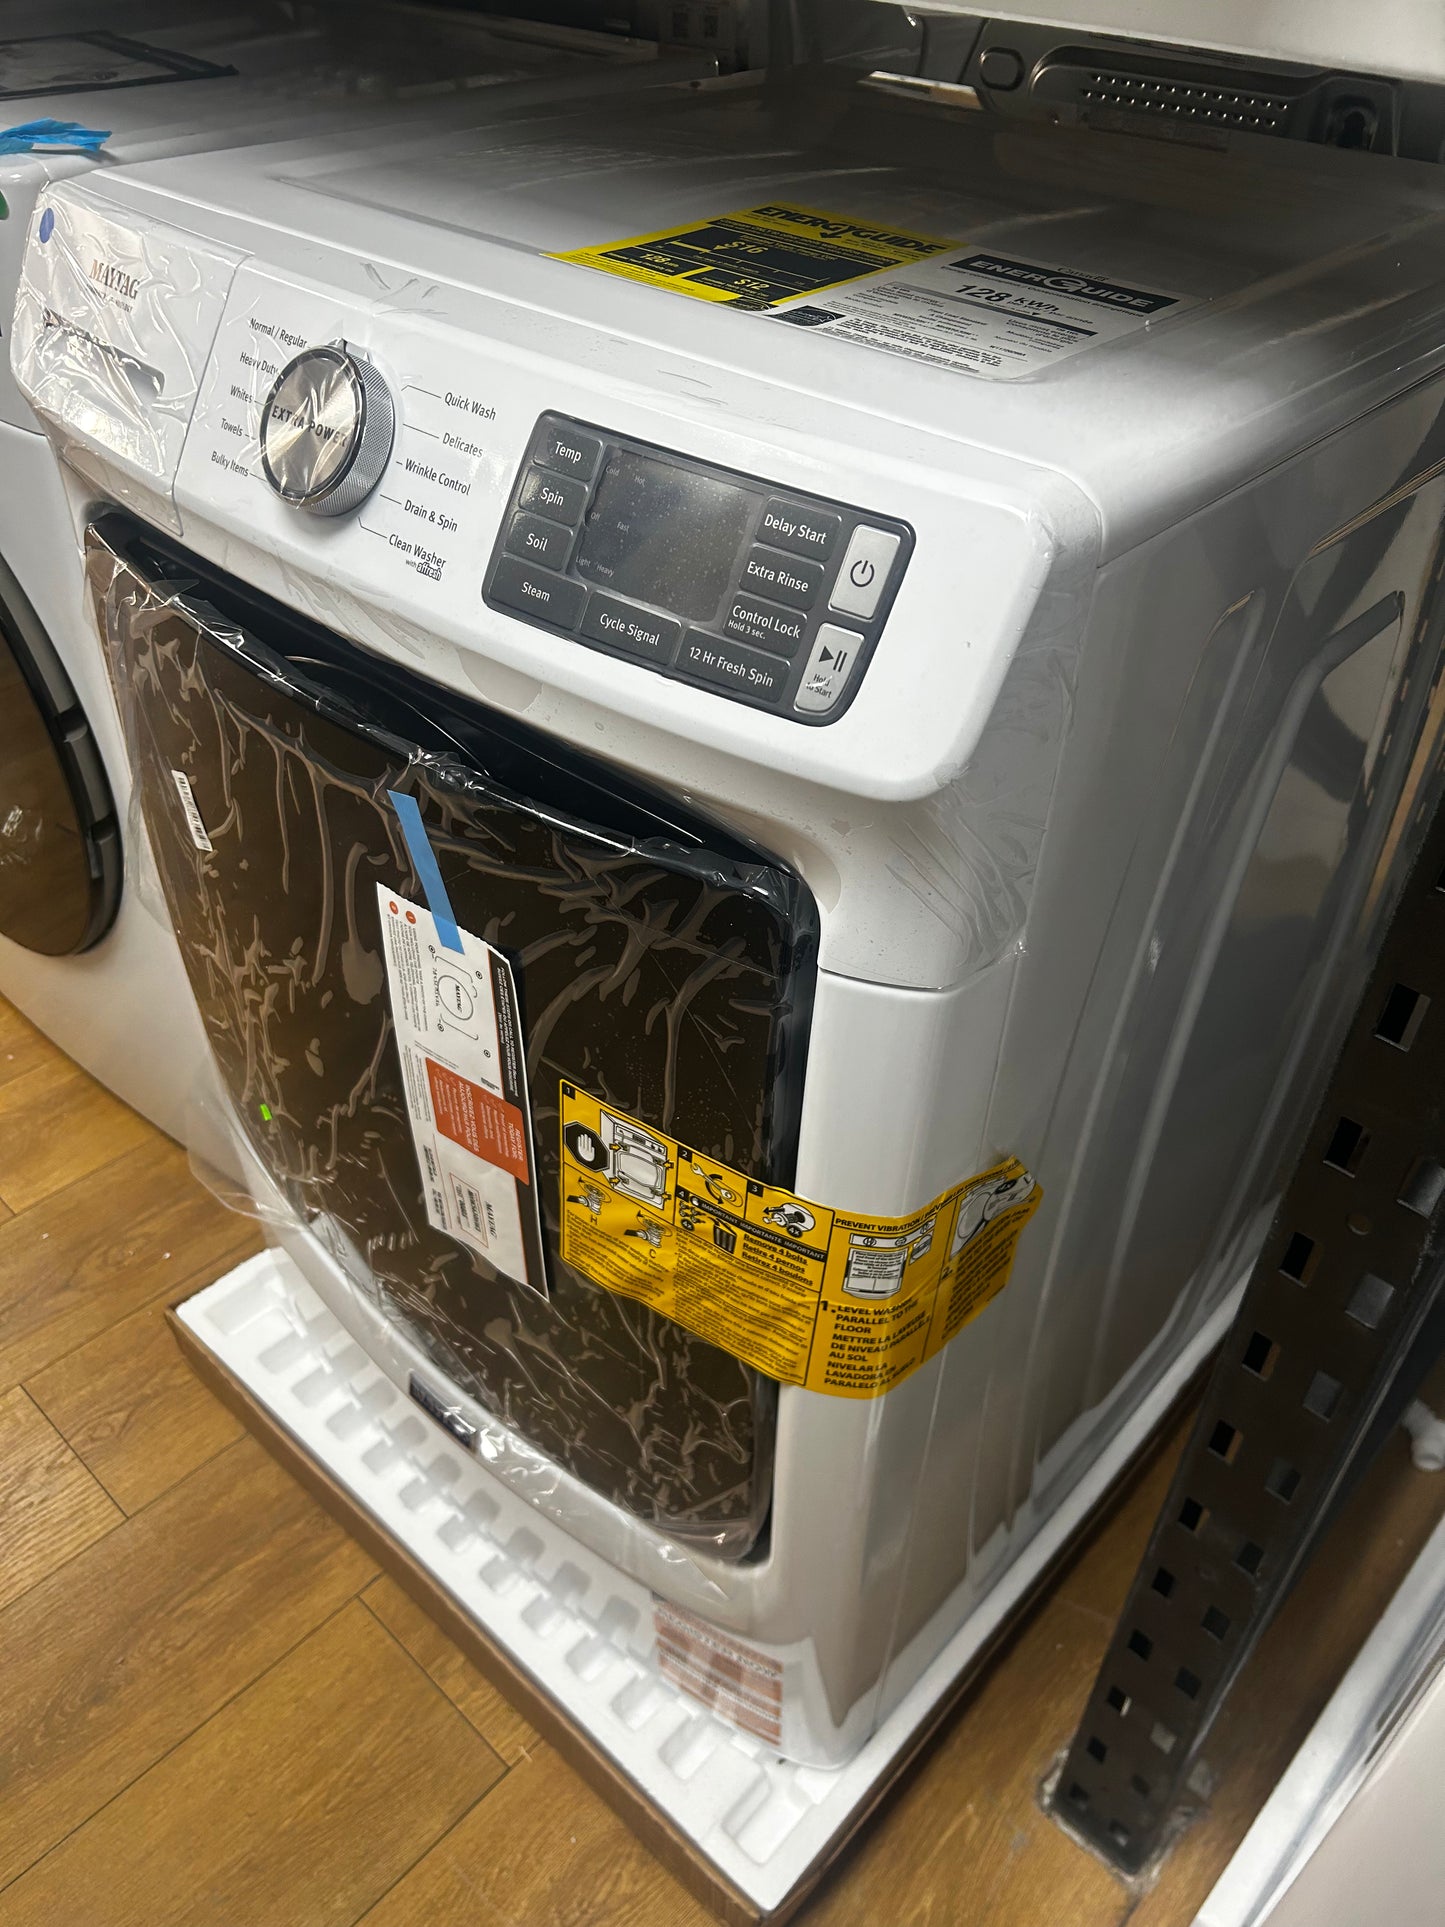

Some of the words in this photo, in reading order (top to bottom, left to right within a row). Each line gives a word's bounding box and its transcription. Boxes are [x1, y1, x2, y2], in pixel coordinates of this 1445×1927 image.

[752, 206, 948, 255] ENERGYGUIDE
[89, 258, 140, 300] MAYTAG
[969, 260, 1154, 308] ENERGUIDE
[955, 284, 1013, 301] 128
[1013, 297, 1059, 312] kWh
[249, 318, 275, 336] Normal
[280, 329, 308, 349] Regular
[240, 352, 260, 369] Heavy
[230, 385, 253, 404] Whites
[444, 392, 469, 411] Quick
[471, 401, 497, 421] Wash
[221, 418, 243, 437] Towels
[271, 405, 305, 428] EXTRA
[308, 419, 349, 447] POWER
[442, 432, 484, 458] Delicates
[555, 441, 582, 464] Temp
[211, 451, 231, 467] Bulky
[231, 460, 249, 477] Items
[605, 466, 620, 476] Cold
[405, 458, 437, 482] Wrinkle
[438, 472, 471, 496] Control
[539, 486, 565, 507] Spin
[404, 499, 427, 519] Drain
[428, 510, 436, 523] &
[437, 514, 459, 532] Spin
[590, 511, 601, 521] Off
[617, 521, 630, 533] Fast
[764, 513, 797, 537] Delay
[797, 524, 827, 545] Start
[389, 534, 413, 553] Clean
[413, 545, 446, 569] Washer
[525, 532, 548, 552] Soil
[405, 559, 417, 568] with
[416, 562, 443, 581] affresh
[575, 556, 591, 567] Light
[597, 563, 614, 577] Heavy
[747, 561, 774, 581] Extra
[777, 571, 809, 592] Rinse
[521, 581, 551, 602] Steam
[600, 613, 626, 634] Cycle
[627, 623, 661, 646] Signal
[728, 620, 745, 633] Hold
[746, 626, 751, 634] 3
[751, 629, 766, 640] sec.
[732, 605, 773, 629] Control
[774, 620, 801, 639] Lock
[689, 646, 701, 660] 12
[702, 651, 715, 665] Hr
[717, 656, 746, 677] Fresh
[747, 668, 774, 687] Spin
[813, 674, 830, 686] Hold
[814, 684, 832, 699] Start
[485, 1200, 497, 1239] MAYTAG
[590, 1214, 598, 1225] H
[835, 1218, 875, 1230] PREVENT
[878, 1218, 920, 1232] VIBRATION
[702, 1202, 738, 1224] IMPORTANT
[740, 1219, 782, 1243] IMPORTANTE
[784, 1240, 825, 1259] IMPORTANT
[649, 1249, 657, 1259] C
[743, 1243, 768, 1256] Retire
[776, 1255, 805, 1274] pernos
[744, 1233, 778, 1251] Remove
[784, 1248, 807, 1264] bolts
[742, 1252, 771, 1267] Retirez
[778, 1263, 813, 1286] boulons
[821, 1301, 836, 1313] 1.
[838, 1305, 871, 1315] LEVEL
[836, 1314, 889, 1325] PARALLEL
[892, 1311, 903, 1320] TO
[833, 1334, 876, 1344] METTRE
[878, 1336, 891, 1344] LA
[834, 1324, 871, 1334] FLOOR
[829, 1351, 845, 1359] AU
[847, 1354, 868, 1362] SOL
[848, 1343, 888, 1353] NIVEAU
[826, 1369, 884, 1380] LAVADORA
[827, 1361, 874, 1372] NIVELAR
[824, 1378, 878, 1388] PARALELO
